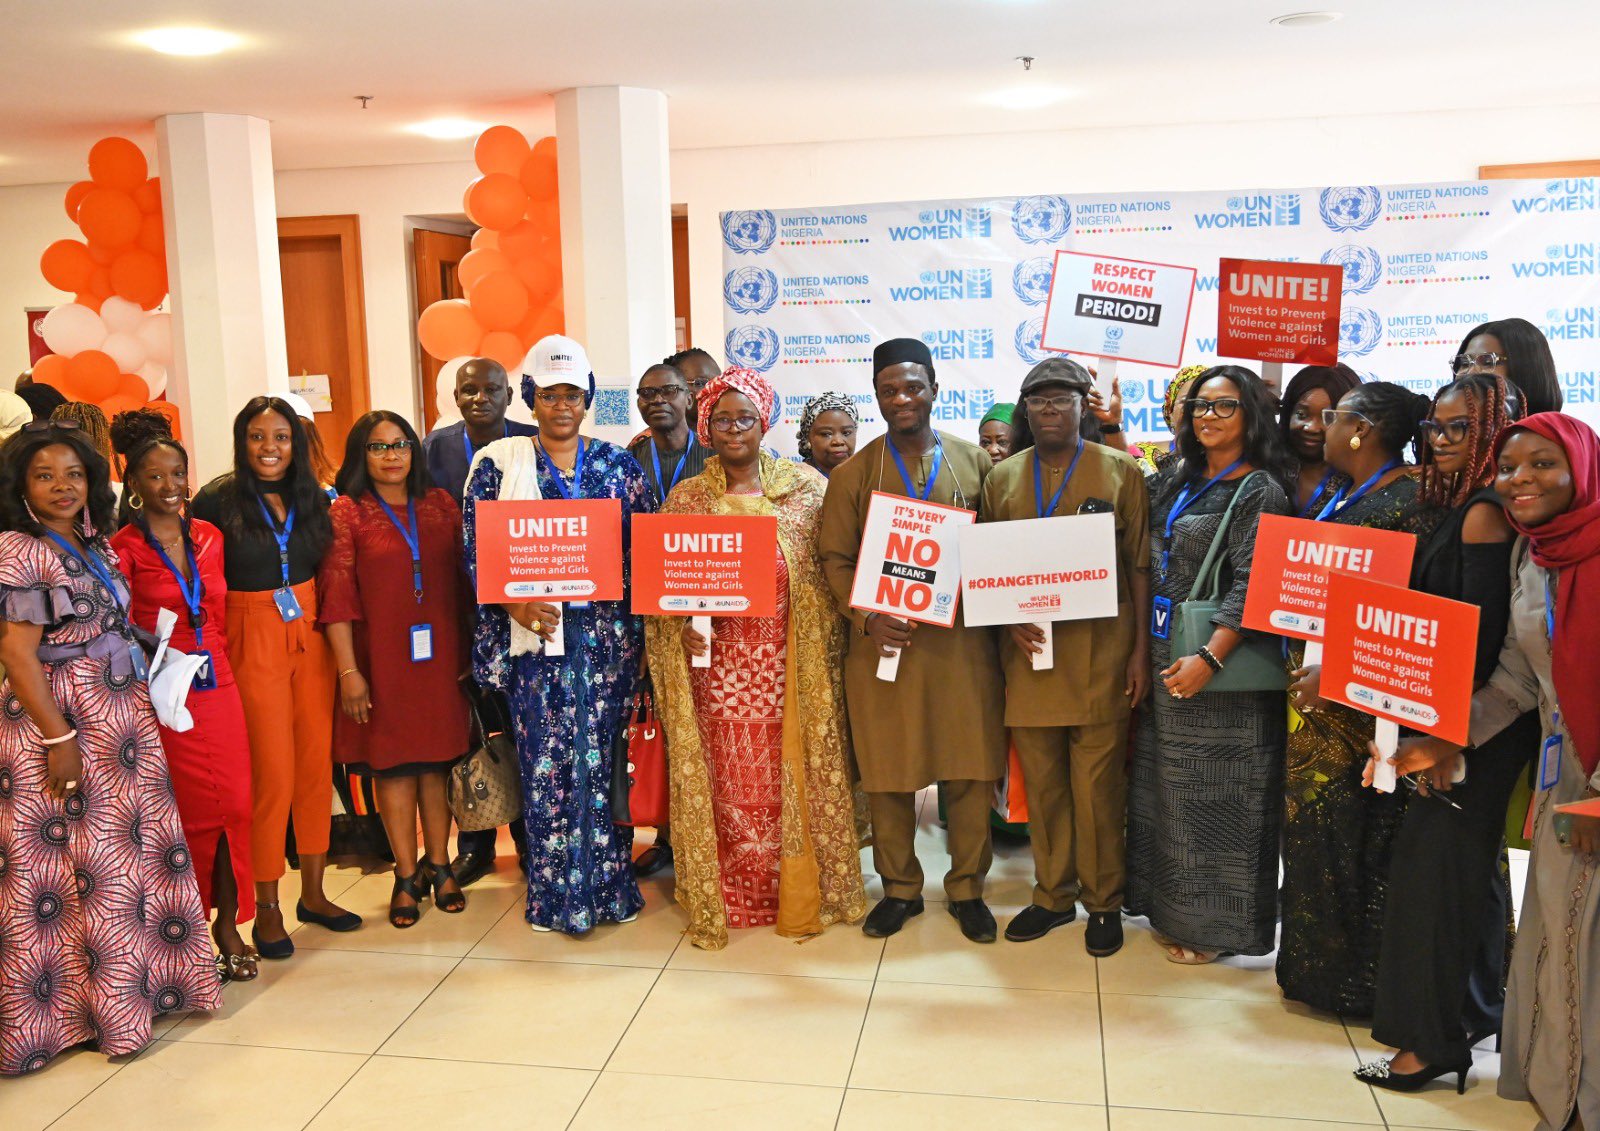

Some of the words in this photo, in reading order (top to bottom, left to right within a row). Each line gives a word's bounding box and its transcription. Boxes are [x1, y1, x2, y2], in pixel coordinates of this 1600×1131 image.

[1387, 189, 1432, 200] UNITED
[1436, 186, 1489, 198] NATIONS
[1565, 179, 1594, 194] UN
[1076, 203, 1117, 214] UNITED
[1120, 201, 1171, 213] NATIONS
[1244, 195, 1271, 211] UN
[1387, 201, 1437, 213] NIGERIA
[1512, 195, 1594, 214] WOMEN
[781, 217, 819, 227] UNITED
[821, 214, 868, 225] NATIONS
[936, 209, 962, 223] UN
[1076, 215, 1122, 226] NIGERIA
[1194, 212, 1271, 229] WOMEN
[781, 228, 824, 238] NIGERIA
[889, 225, 962, 241] WOMEN
[1387, 253, 1432, 265] UNITED
[1436, 251, 1489, 262] NATIONS
[1564, 243, 1594, 259] UN
[1093, 262, 1156, 282] RESPECT
[1387, 265, 1437, 276] NIGERIA
[1512, 260, 1594, 278] WOMEN
[782, 277, 820, 287] UNITED
[823, 275, 869, 286] NATIONS
[937, 270, 963, 284] UN
[782, 288, 825, 298] NIGERIA
[889, 286, 963, 302] WOMEN
[1091, 279, 1154, 299] WOMEN
[1229, 273, 1330, 303] UNITE!
[1081, 298, 1156, 323] PERIOD!
[1229, 304, 1263, 315] Invest
[1265, 306, 1278, 316] to
[1281, 307, 1326, 320] Prevent
[1565, 307, 1594, 322] UN
[1229, 316, 1277, 329] Violence
[1280, 322, 1323, 334] against
[1387, 315, 1432, 327] UNITED
[1436, 313, 1489, 325] NATIONS
[784, 336, 822, 346] UNITED
[824, 334, 871, 345] NATIONS
[938, 330, 964, 344] UN
[1228, 329, 1272, 342] Women
[1275, 333, 1297, 344] and
[1300, 335, 1327, 346] Girls
[1387, 327, 1437, 339] NIGERIA
[784, 347, 827, 357] NIGERIA
[1257, 351, 1285, 359] WOMEN
[1394, 379, 1433, 390] NITED
[1565, 371, 1595, 387] UN
[940, 390, 966, 404] UN
[1148, 380, 1170, 404] U
[785, 395, 815, 405] UNIT
[894, 505, 915, 518] IT'S
[917, 509, 947, 524] VERY
[508, 516, 588, 538] UNITE!
[891, 518, 932, 534] SIMPLE
[509, 545, 537, 553] Invest
[551, 543, 587, 552] Prevent
[663, 533, 743, 553] UNITE!
[885, 532, 941, 567] NO
[509, 555, 549, 564] Violence
[551, 554, 586, 565] against
[664, 560, 691, 568] Invest
[706, 559, 741, 568] Prevent
[1286, 539, 1374, 573] UNITE!
[510, 566, 546, 575] Women
[548, 566, 566, 574] and
[567, 565, 589, 574] Girls
[664, 569, 703, 579] Violence
[705, 570, 740, 581] against
[891, 565, 927, 580] MEANS
[1283, 568, 1312, 583] Invest
[1313, 575, 1324, 584] to
[664, 581, 700, 590] Women
[702, 581, 720, 590] and
[721, 581, 743, 590] Girls
[968, 568, 1109, 590] #ORANGETHEWORLD
[875, 575, 932, 612] NO
[1281, 580, 1322, 597] Violence
[1018, 601, 1049, 609] WOMEN
[1279, 593, 1316, 609] Women
[1355, 604, 1439, 648] UNITE!
[1353, 637, 1381, 653] Invest
[1383, 646, 1393, 656] to
[1395, 648, 1434, 667] Prevent
[1353, 650, 1391, 670] Violence
[1393, 664, 1431, 682] against
[1352, 664, 1387, 684] Women
[1388, 675, 1408, 690] and
[1409, 681, 1433, 697] Girls
